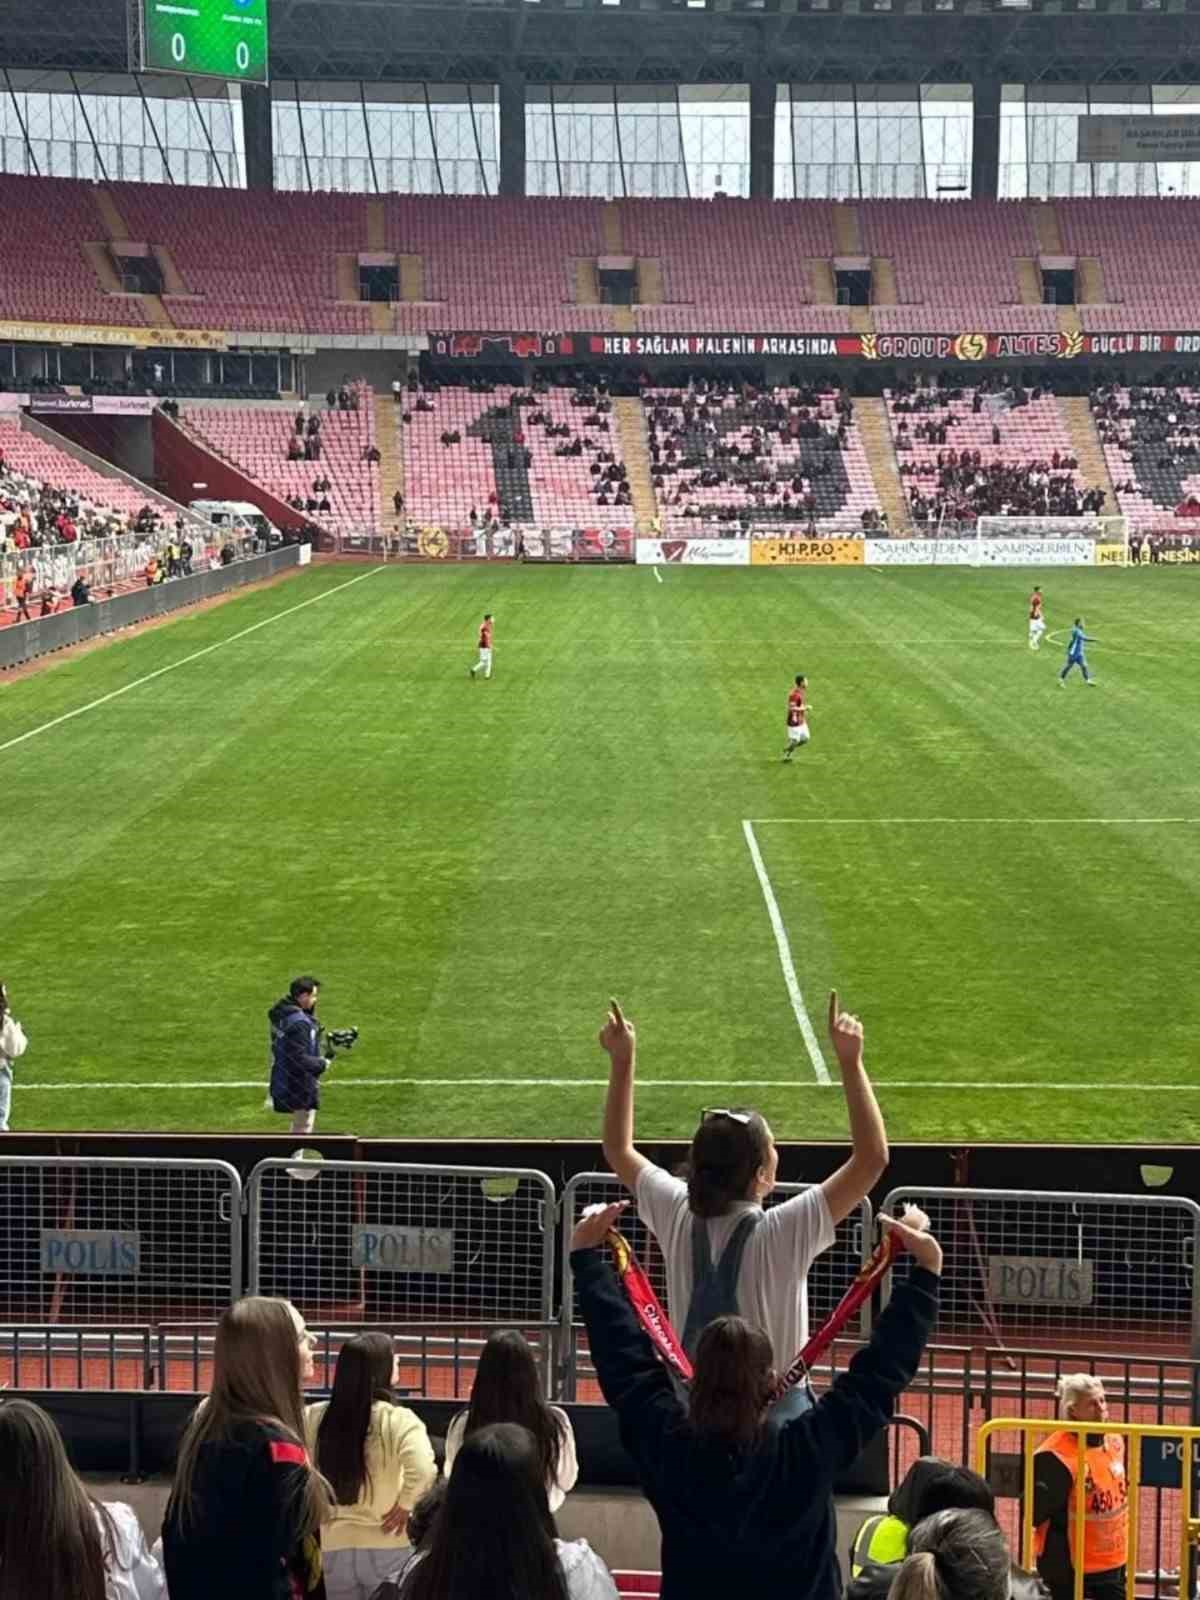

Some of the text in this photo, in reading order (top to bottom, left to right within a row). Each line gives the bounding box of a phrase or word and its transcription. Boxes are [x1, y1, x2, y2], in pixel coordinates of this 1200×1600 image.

[171, 32, 249, 70] 0 0
[604, 336, 631, 354] HER
[637, 335, 690, 354] SAĞLAM
[878, 335, 1062, 358] GROUP ALTES
[778, 543, 834, 556] HIPPO
[47, 1235, 136, 1269] POLİS
[1001, 1263, 1082, 1299] POLİS
